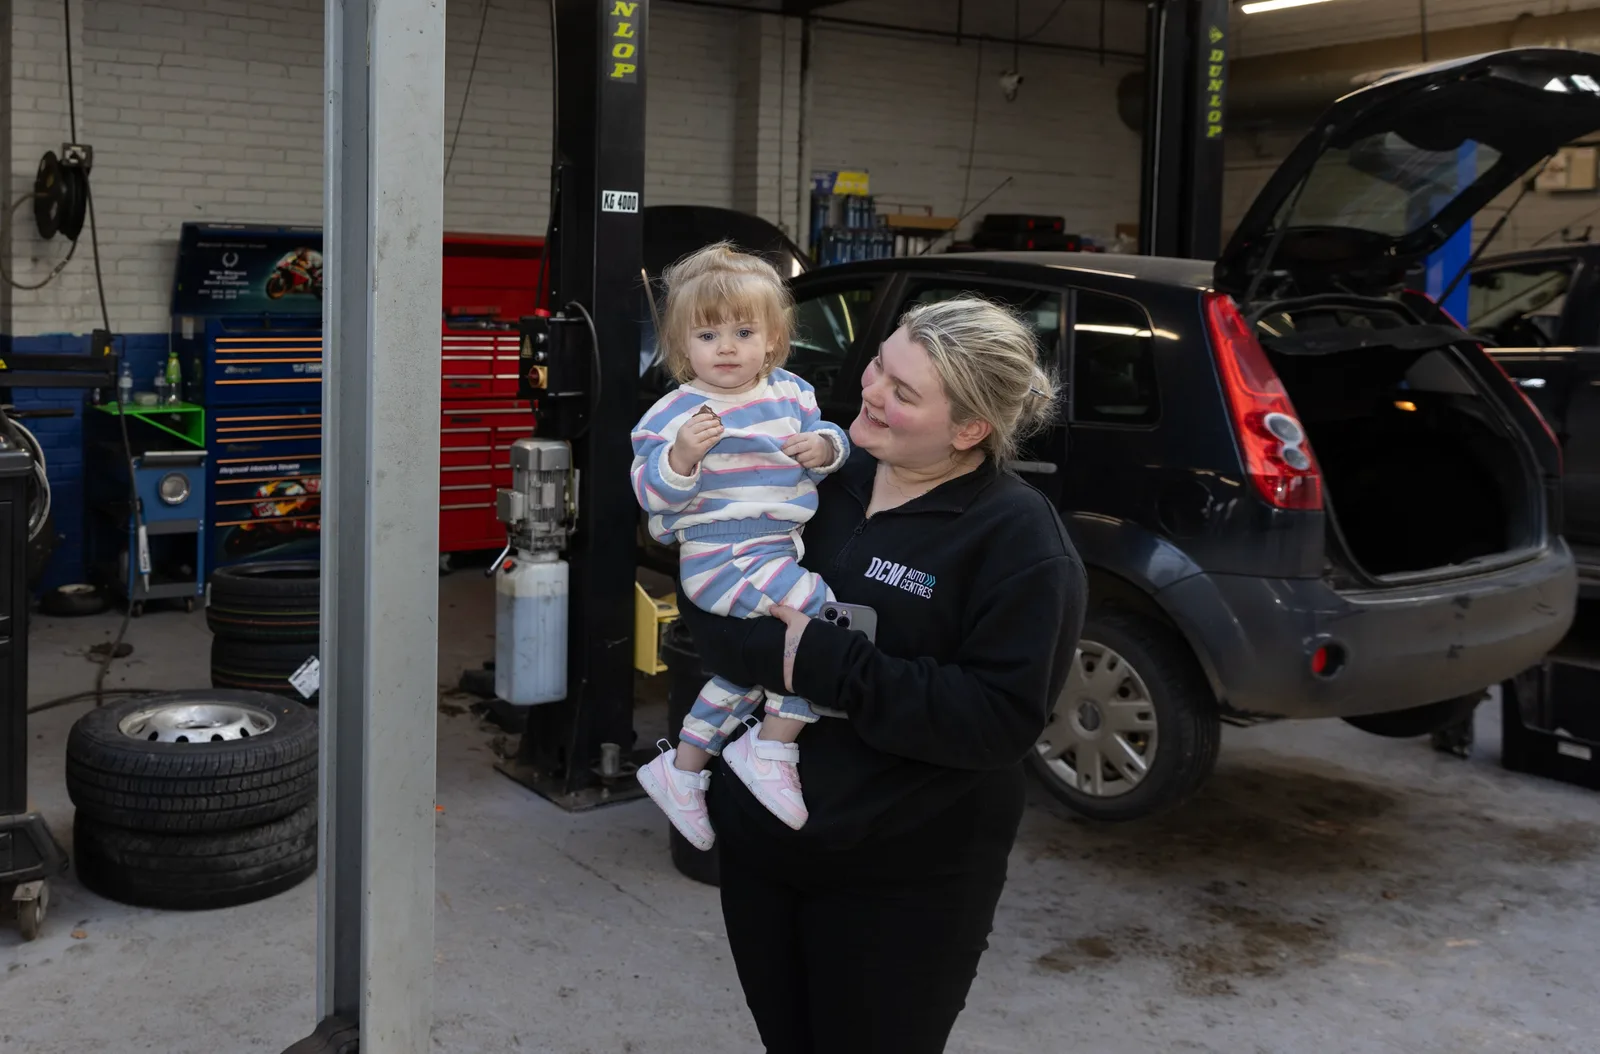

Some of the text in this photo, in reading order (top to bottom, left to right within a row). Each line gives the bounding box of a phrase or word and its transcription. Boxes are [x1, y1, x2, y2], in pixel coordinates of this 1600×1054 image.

[610, 1, 638, 78] NLOP
[1207, 49, 1224, 137] DUNLOP
[604, 193, 637, 210] KG 4000
[864, 557, 907, 586] DCM
[905, 568, 926, 583] AUTO
[900, 579, 933, 599] CENTRES
